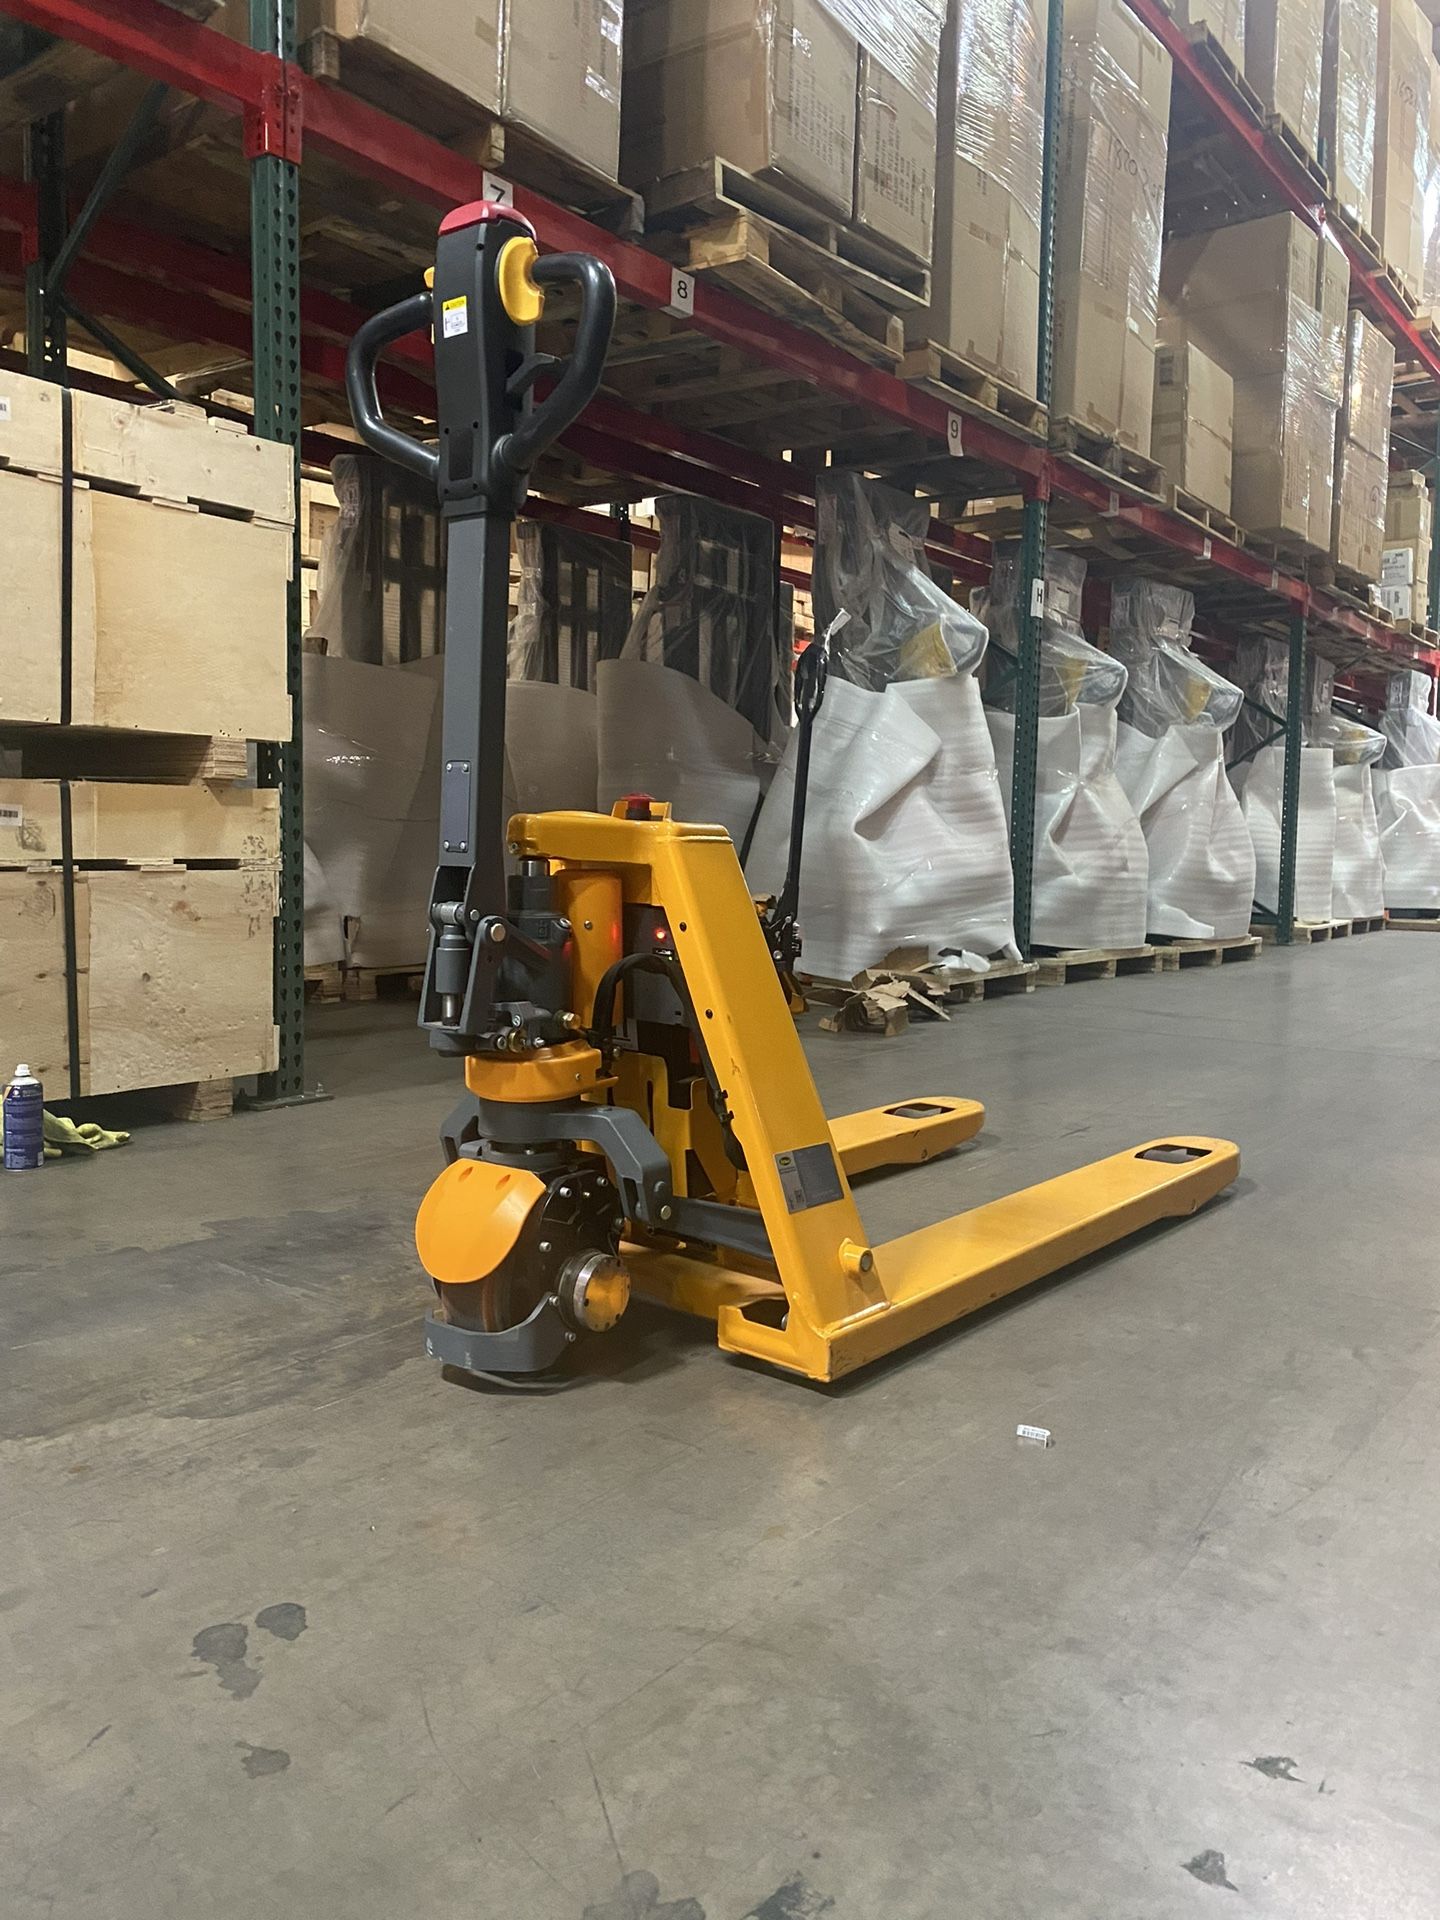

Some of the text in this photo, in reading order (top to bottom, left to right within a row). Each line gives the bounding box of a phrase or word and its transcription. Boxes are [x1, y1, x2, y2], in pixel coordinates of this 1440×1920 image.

[490, 183, 505, 202] 7
[677, 280, 688, 299] 8
[951, 419, 959, 439] 9
[1036, 587, 1043, 604] H
